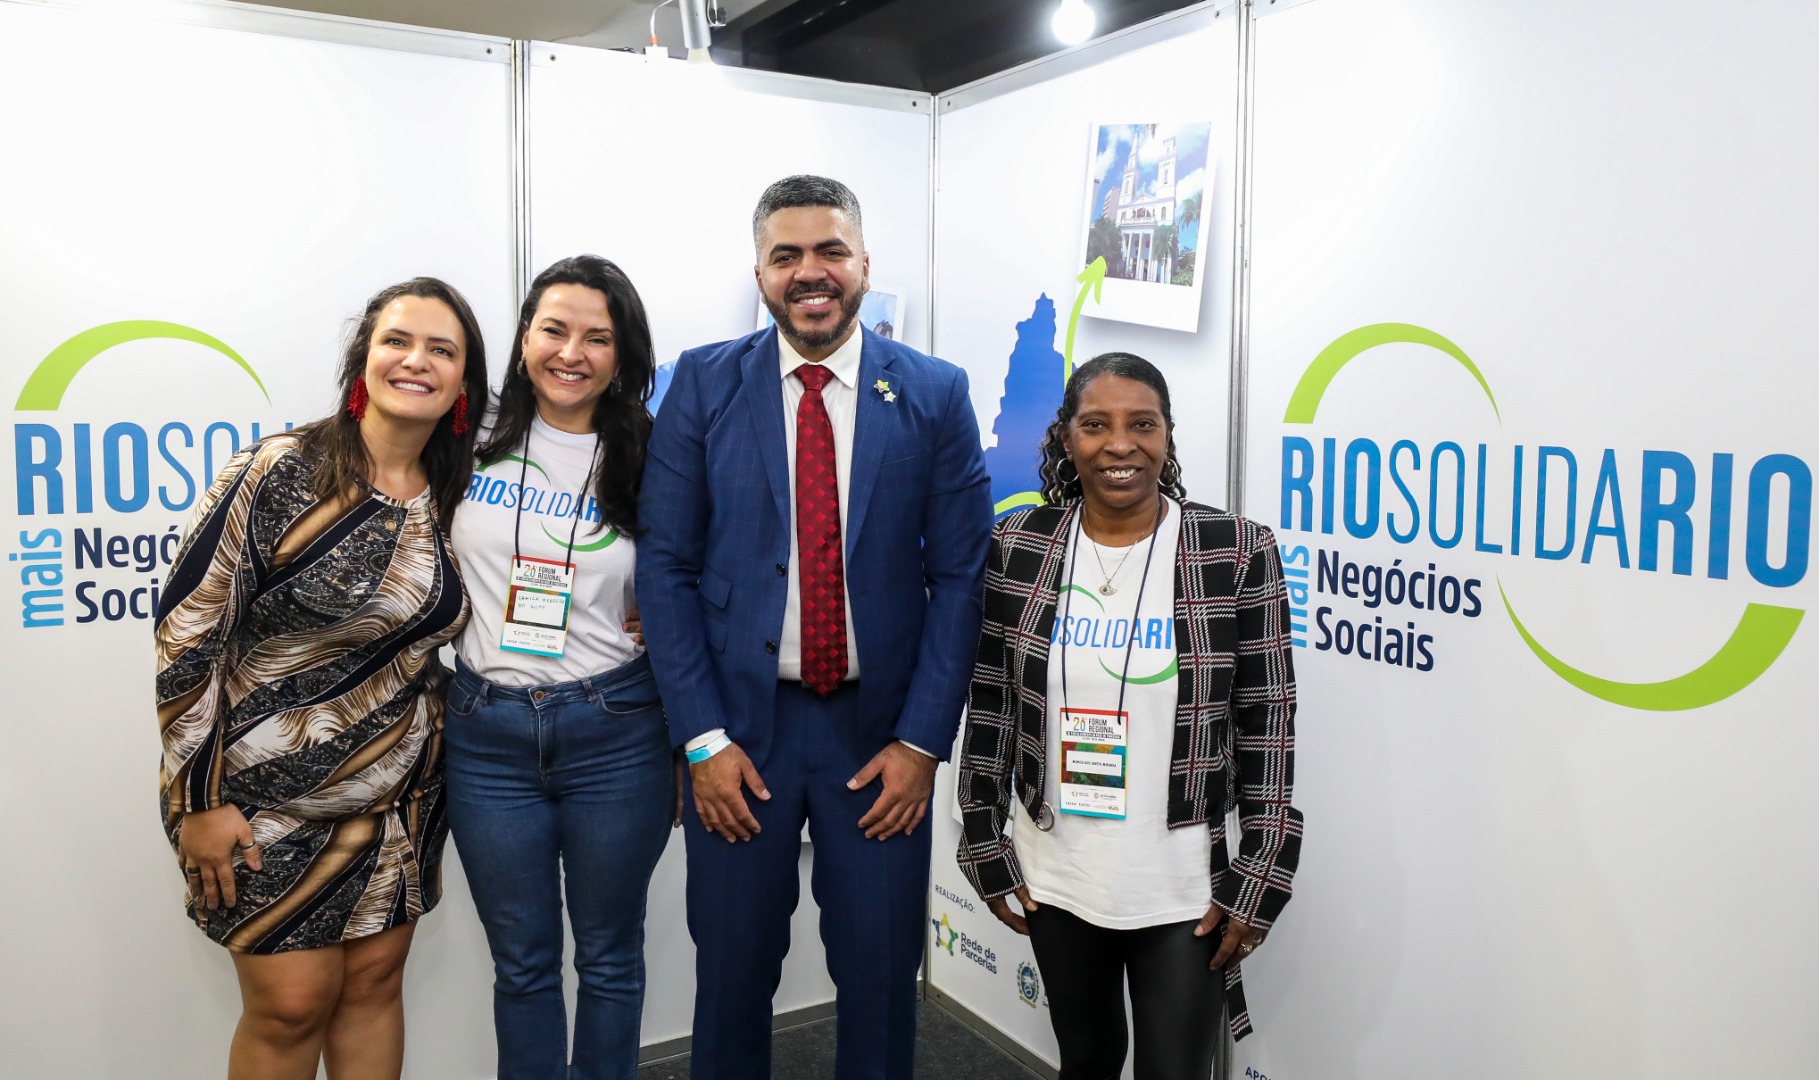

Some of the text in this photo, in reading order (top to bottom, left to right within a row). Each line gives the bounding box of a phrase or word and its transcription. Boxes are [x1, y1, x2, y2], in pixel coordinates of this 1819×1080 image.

[1280, 436, 1813, 588] RIOSOLIDARIO
[9, 528, 64, 628] mais
[1316, 548, 1482, 618] Negócios
[1315, 606, 1434, 672] Sociais
[1088, 725, 1115, 735] REGIONAL
[935, 884, 976, 913] REALIZAÇÃO:
[960, 944, 998, 975] Parcerias
[961, 932, 996, 962] Rede de
